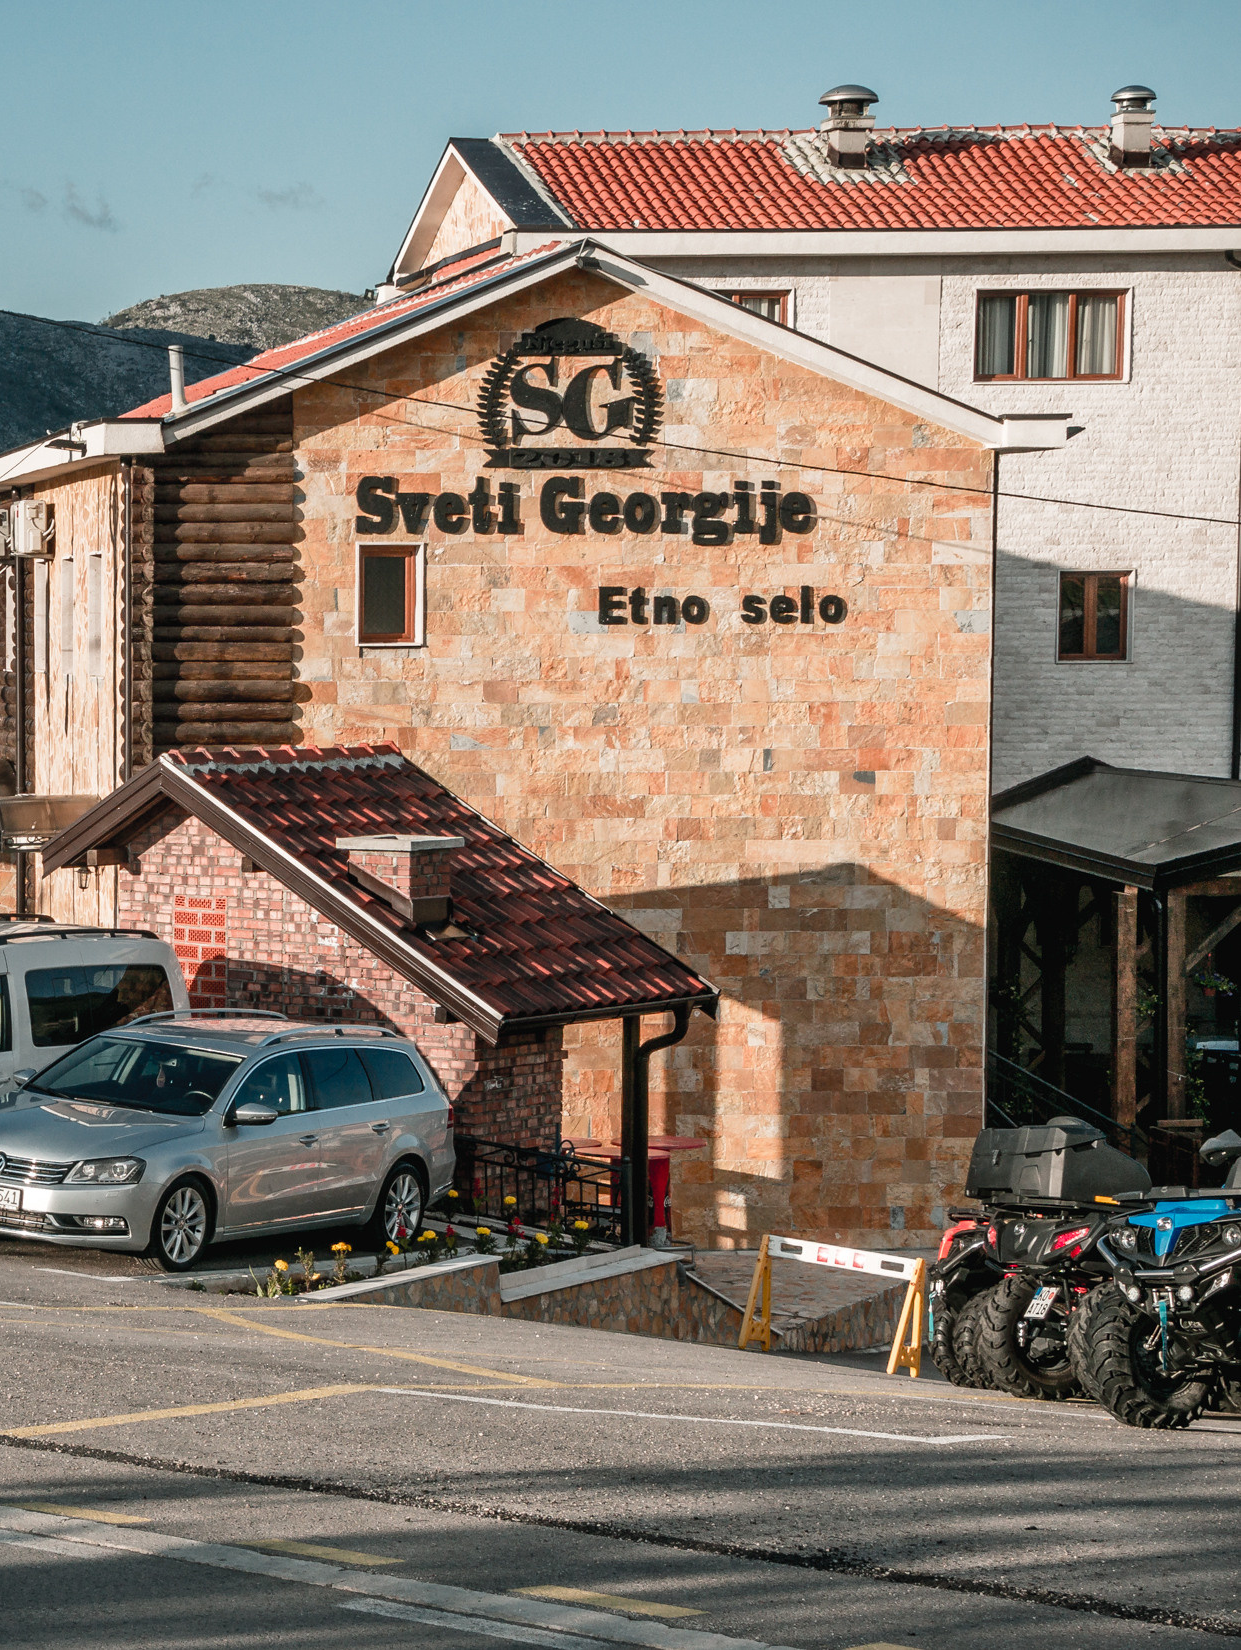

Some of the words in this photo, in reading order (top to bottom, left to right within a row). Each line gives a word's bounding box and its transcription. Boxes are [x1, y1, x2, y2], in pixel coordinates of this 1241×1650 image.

[510, 356, 640, 446] SG
[513, 449, 626, 468] 2018
[356, 476, 523, 535] Sveti
[540, 476, 816, 546] Georgije
[599, 586, 709, 625] Etno
[741, 585, 847, 625] selo
